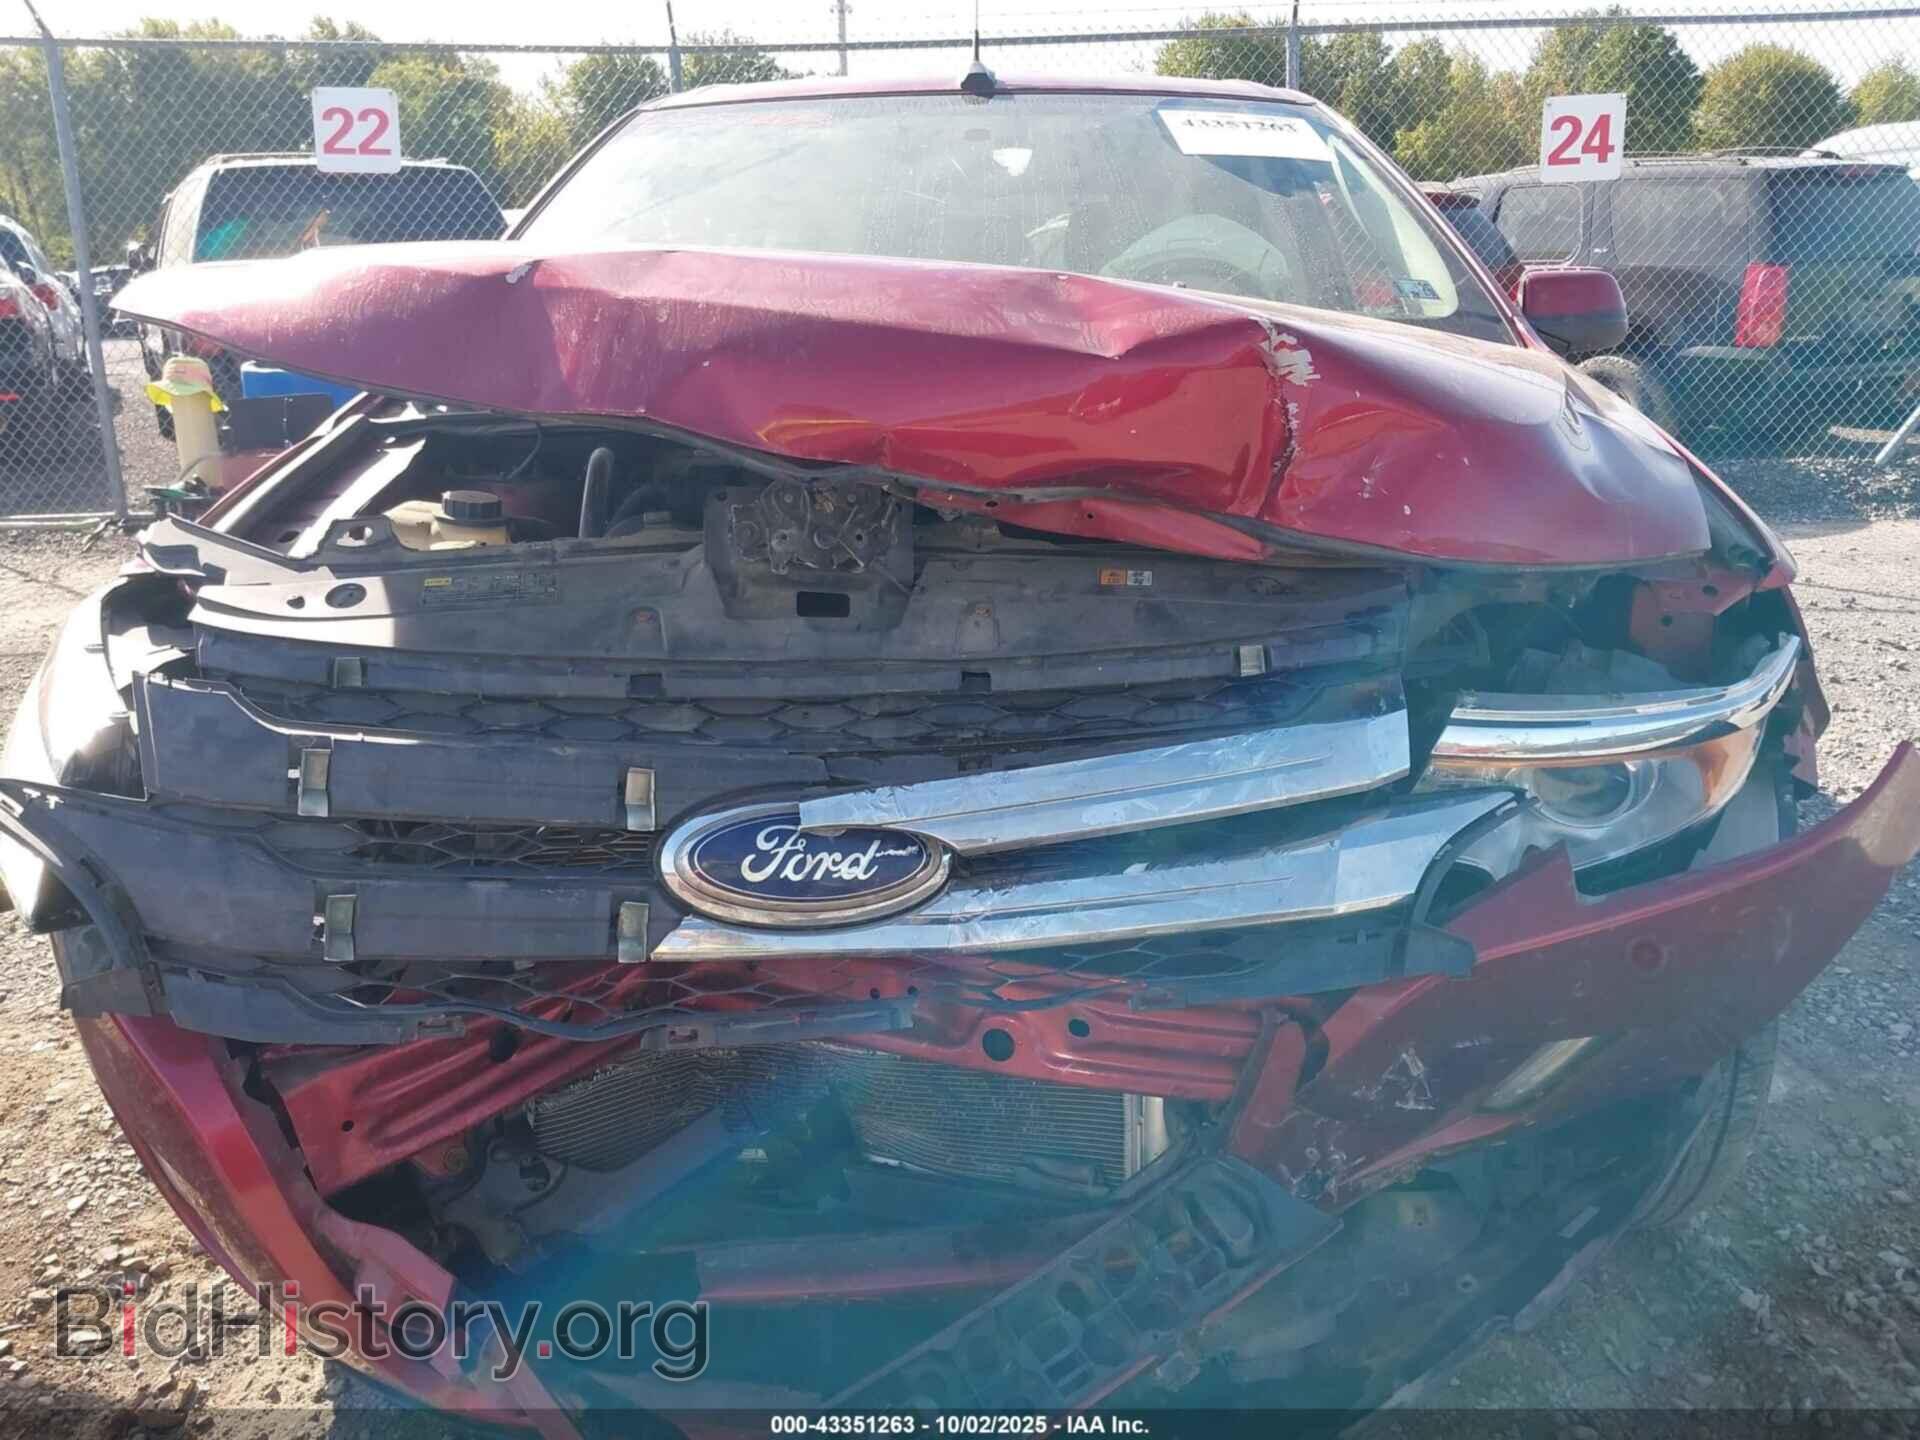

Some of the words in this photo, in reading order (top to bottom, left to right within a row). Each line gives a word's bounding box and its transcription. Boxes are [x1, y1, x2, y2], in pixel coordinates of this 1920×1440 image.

[322, 106, 392, 155] 22
[1547, 113, 1615, 166] 24
[740, 824, 881, 882] Ford
